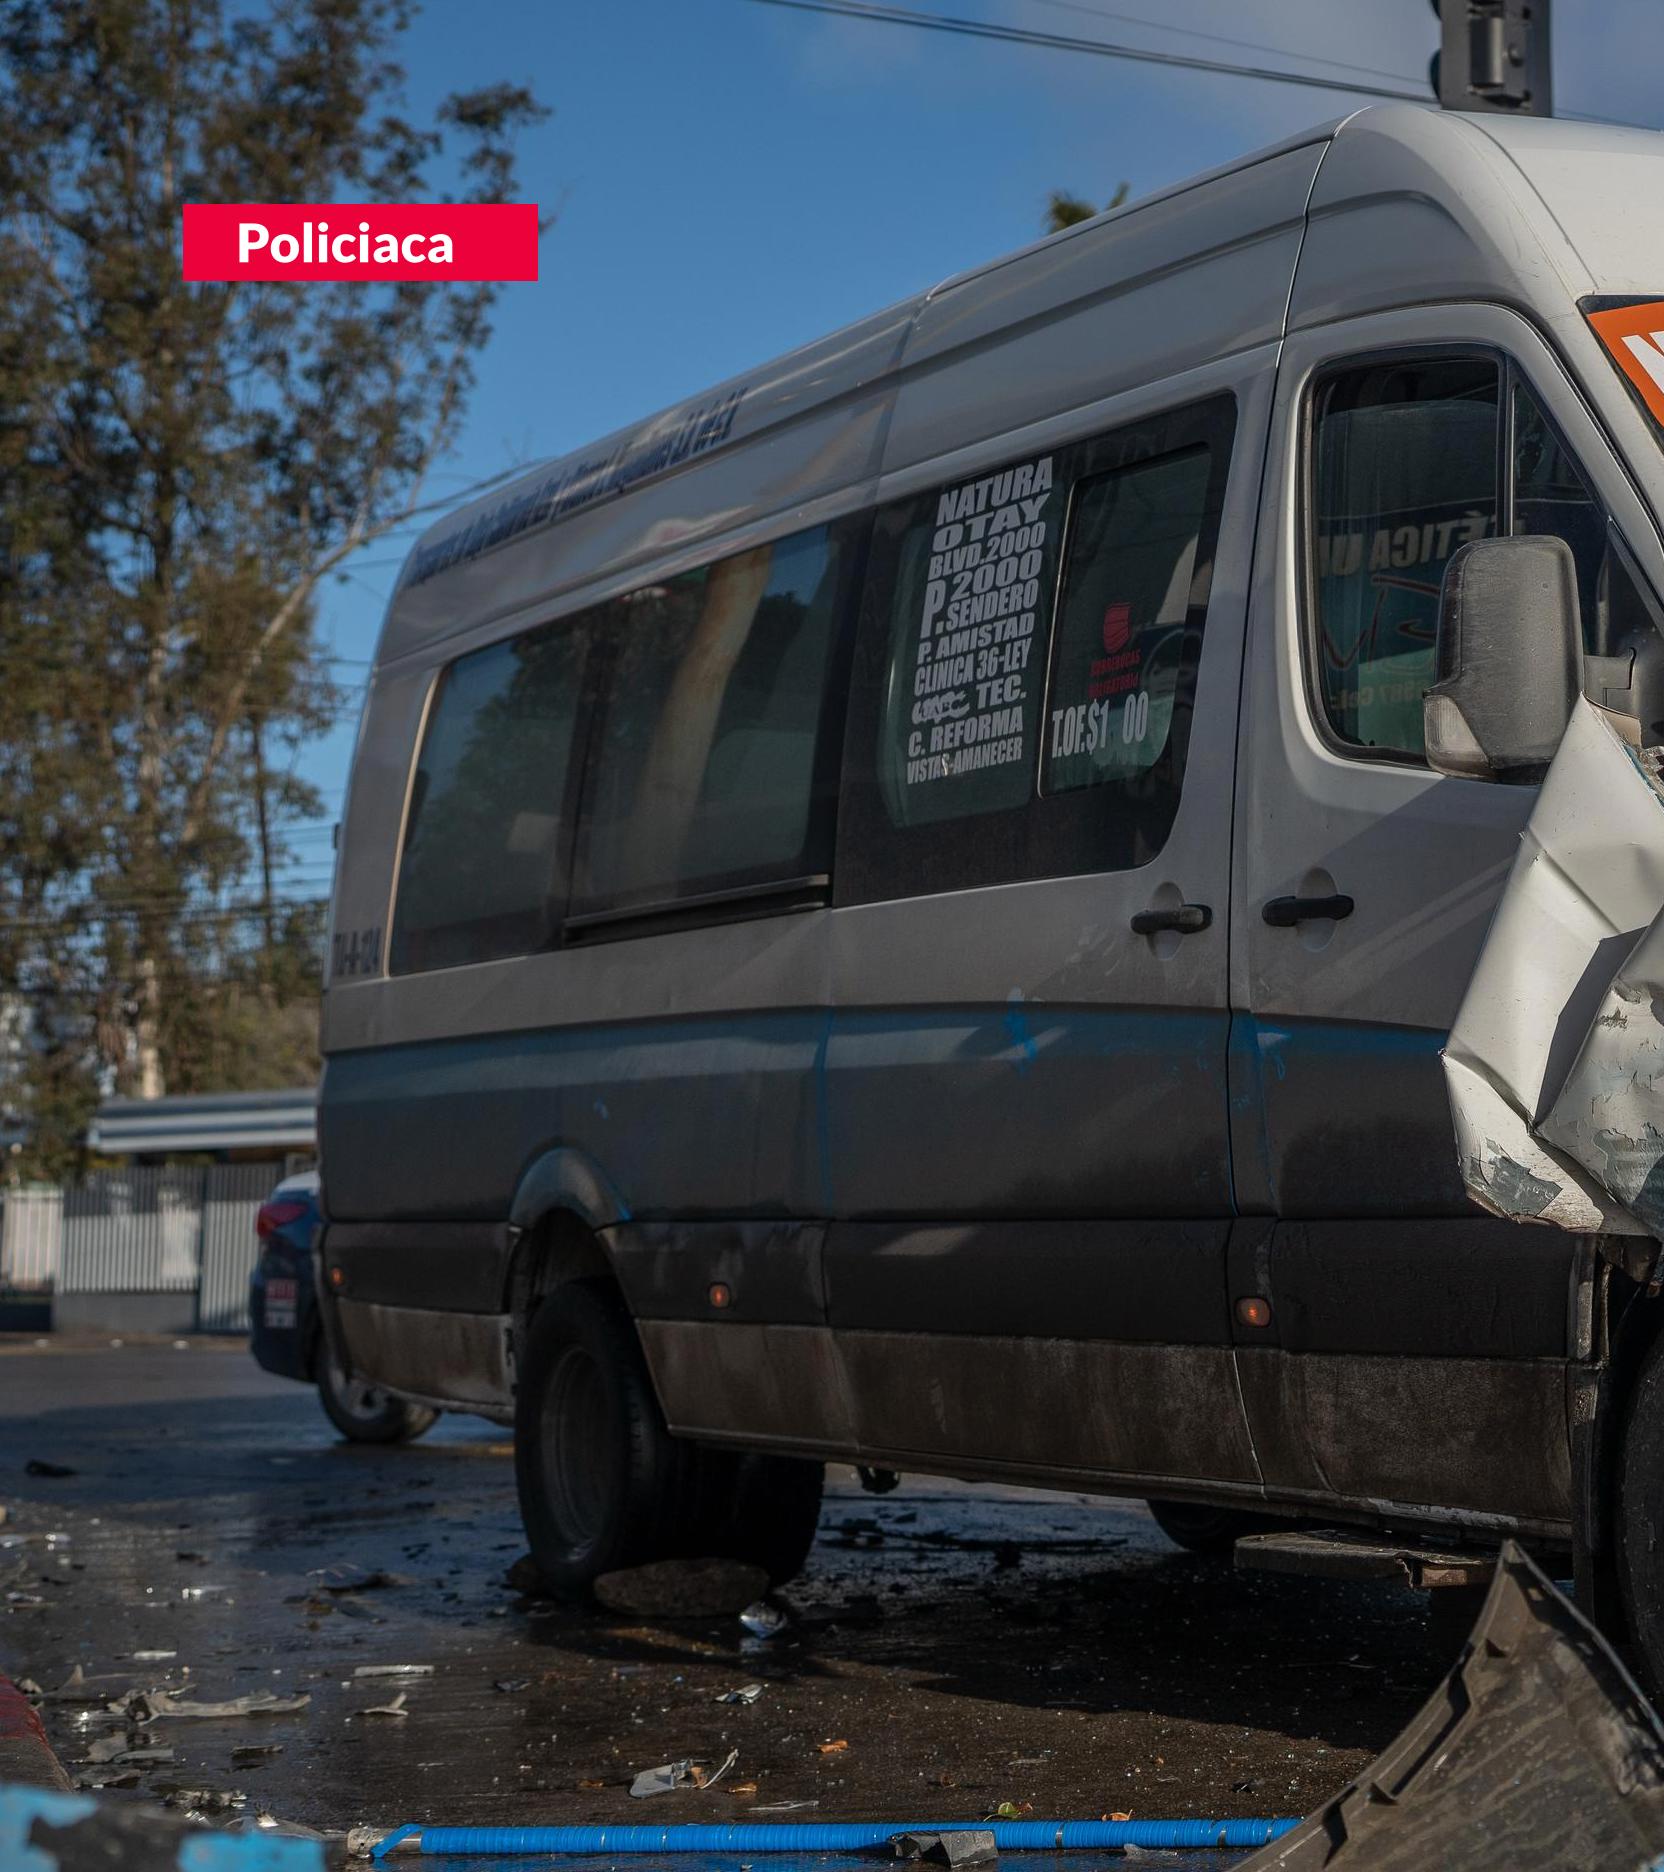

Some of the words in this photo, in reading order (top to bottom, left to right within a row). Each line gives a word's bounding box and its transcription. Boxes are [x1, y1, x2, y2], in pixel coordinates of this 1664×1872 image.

[936, 456, 1053, 527] NATURA
[932, 493, 1050, 552] OTAY
[920, 579, 946, 639] P.
[950, 549, 1042, 602] 2000
[945, 578, 1039, 631] SENDERO
[917, 641, 933, 665] P.
[935, 612, 1035, 660] AMISTAD
[914, 653, 974, 697] CLINICA
[976, 637, 1033, 680] 36-LEY
[976, 674, 1027, 710] TEC.
[908, 731, 926, 758] C.
[930, 706, 1024, 753] REFORMA
